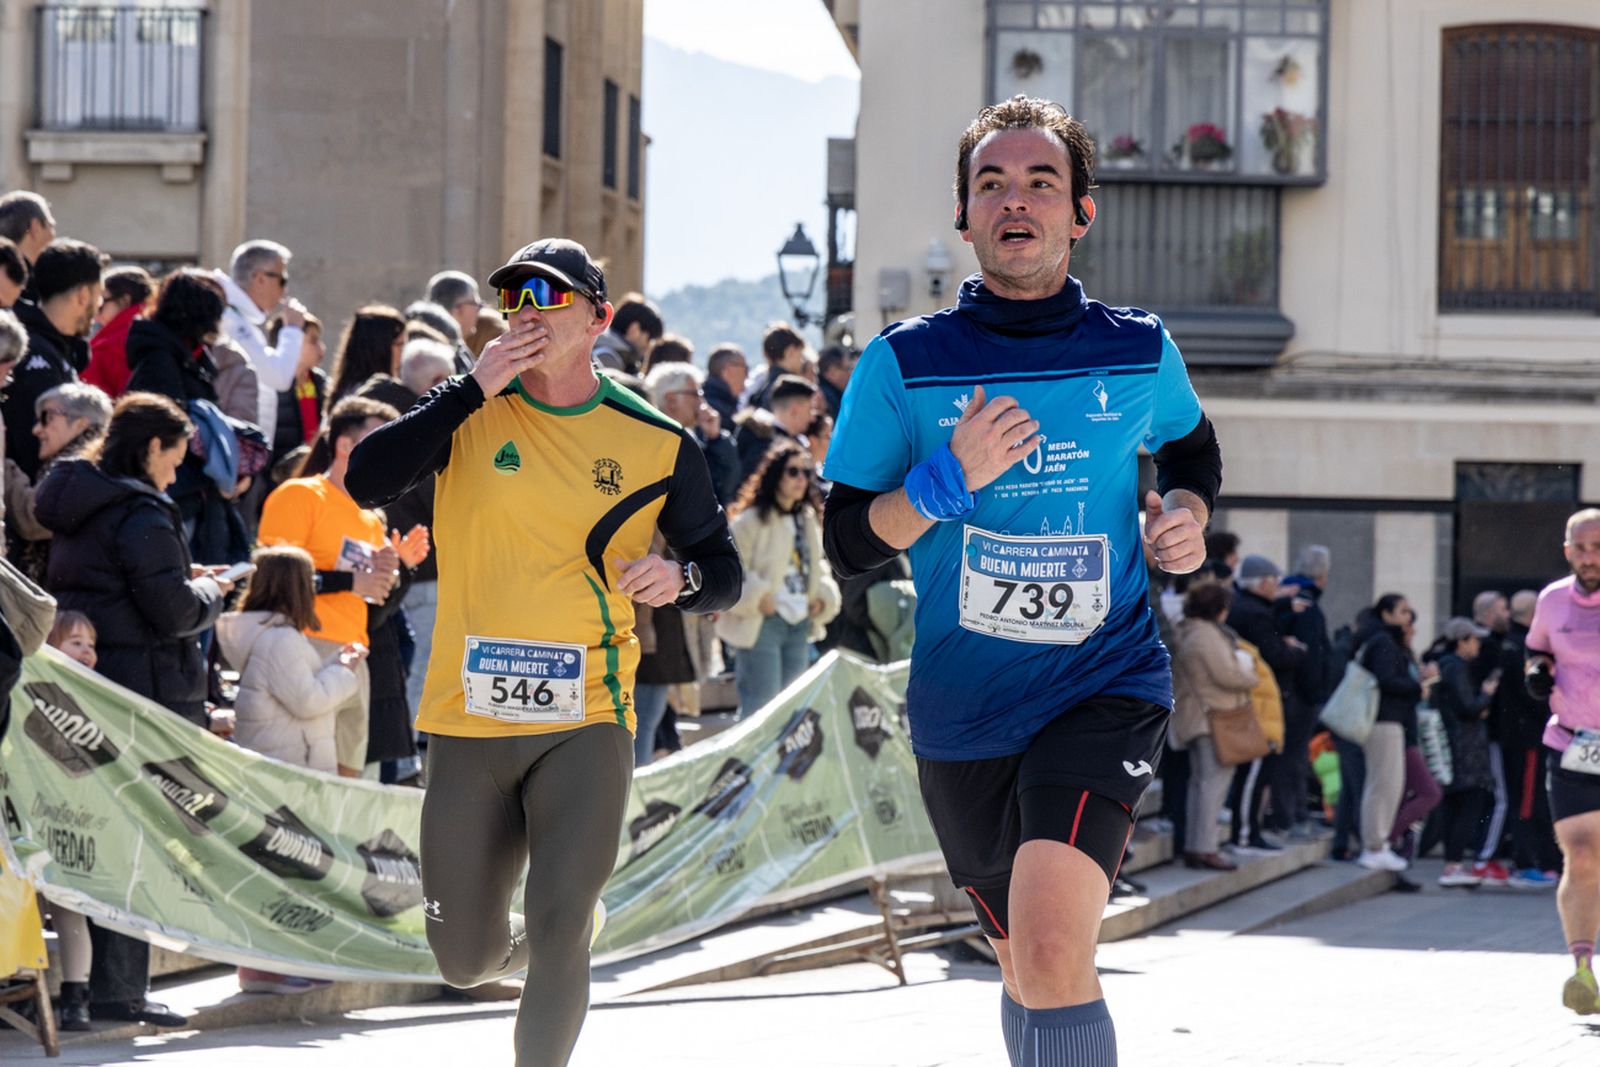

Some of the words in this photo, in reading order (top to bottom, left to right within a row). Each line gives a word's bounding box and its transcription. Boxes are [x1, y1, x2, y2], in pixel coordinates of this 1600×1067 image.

[1048, 441, 1076, 451] MEDIA
[1046, 449, 1090, 462] MARATÓN
[1044, 463, 1067, 473] JAÉN
[982, 541, 991, 551] VI
[992, 544, 1039, 557] CARRERA
[1041, 546, 1089, 557] CAMINATA
[980, 556, 1016, 576] BUENA
[1020, 562, 1067, 578] MUERTE
[991, 580, 1074, 620] 739
[980, 612, 998, 622] PEDRO
[1000, 617, 1029, 626] ANTONIO
[481, 646, 490, 654] VI
[490, 647, 525, 657] CARRERA
[527, 650, 564, 660] CAMINAT
[479, 658, 509, 672] BUENA
[510, 660, 549, 675] MUERTE
[490, 677, 554, 706] 546
